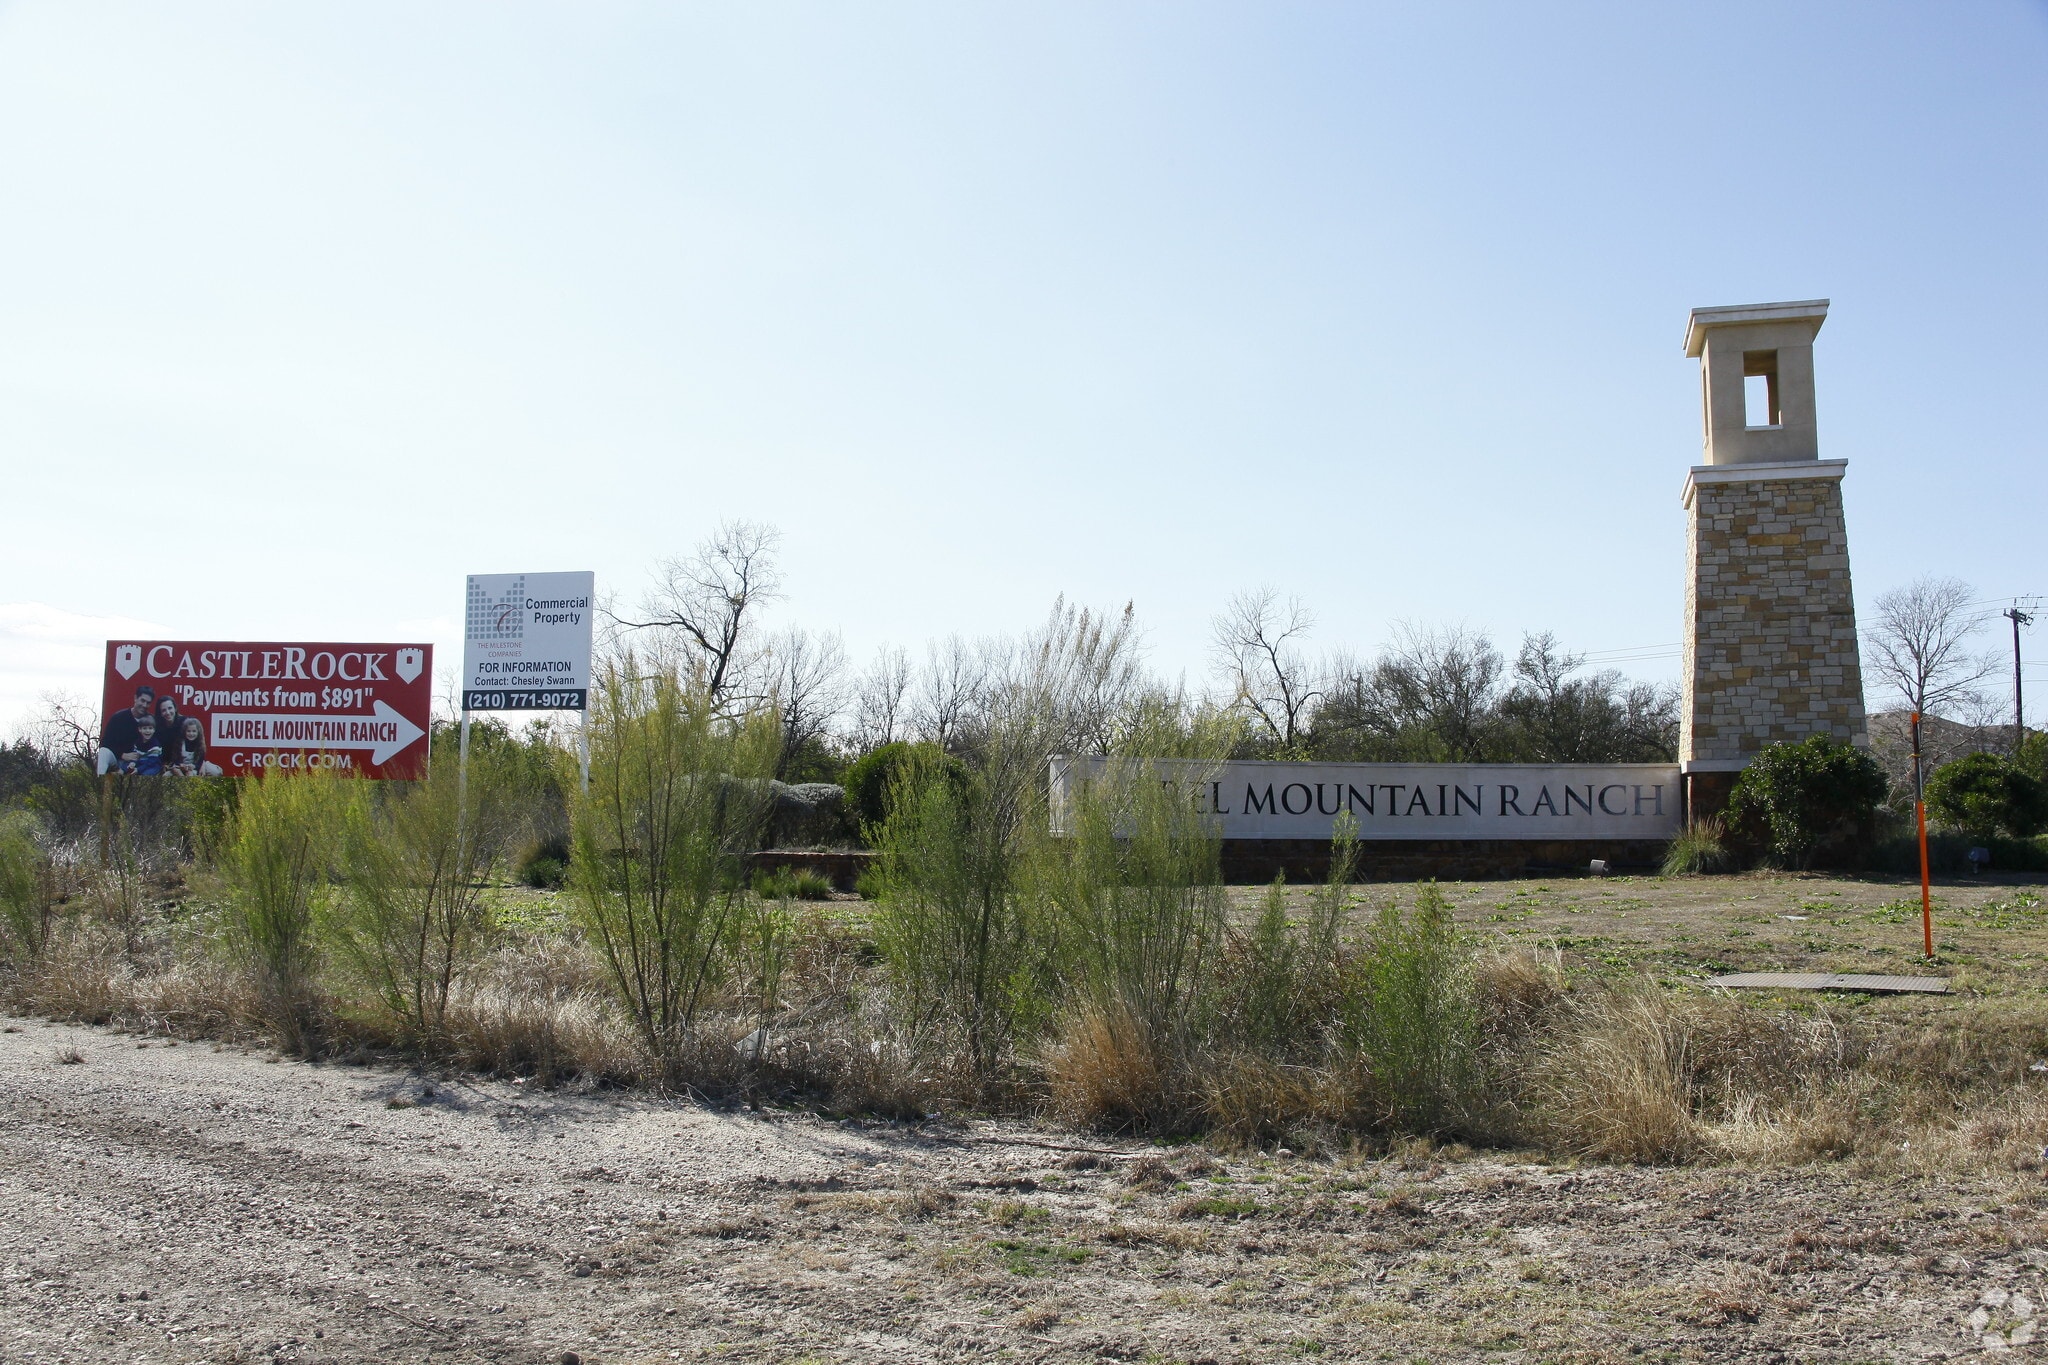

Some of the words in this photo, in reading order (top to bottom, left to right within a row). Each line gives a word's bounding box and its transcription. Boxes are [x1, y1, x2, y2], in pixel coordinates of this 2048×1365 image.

[525, 597, 588, 610] Commercial
[534, 612, 581, 625] Property
[479, 662, 500, 673] FOR
[502, 661, 572, 673] INFORMATION
[474, 676, 509, 686] Contact:
[511, 676, 544, 687] Chesley
[546, 675, 575, 685] Swann
[175, 685, 270, 711] "Payments
[273, 686, 317, 707] from
[321, 687, 374, 709] $891"
[468, 692, 506, 709] (210)
[510, 692, 579, 707] 771-9072
[218, 719, 269, 740] LAUREL
[272, 721, 346, 742] MOUNTAIN
[350, 723, 398, 742] RANCH
[1242, 782, 1482, 816] MOUNTAIN
[1498, 784, 1666, 817] RANCH
